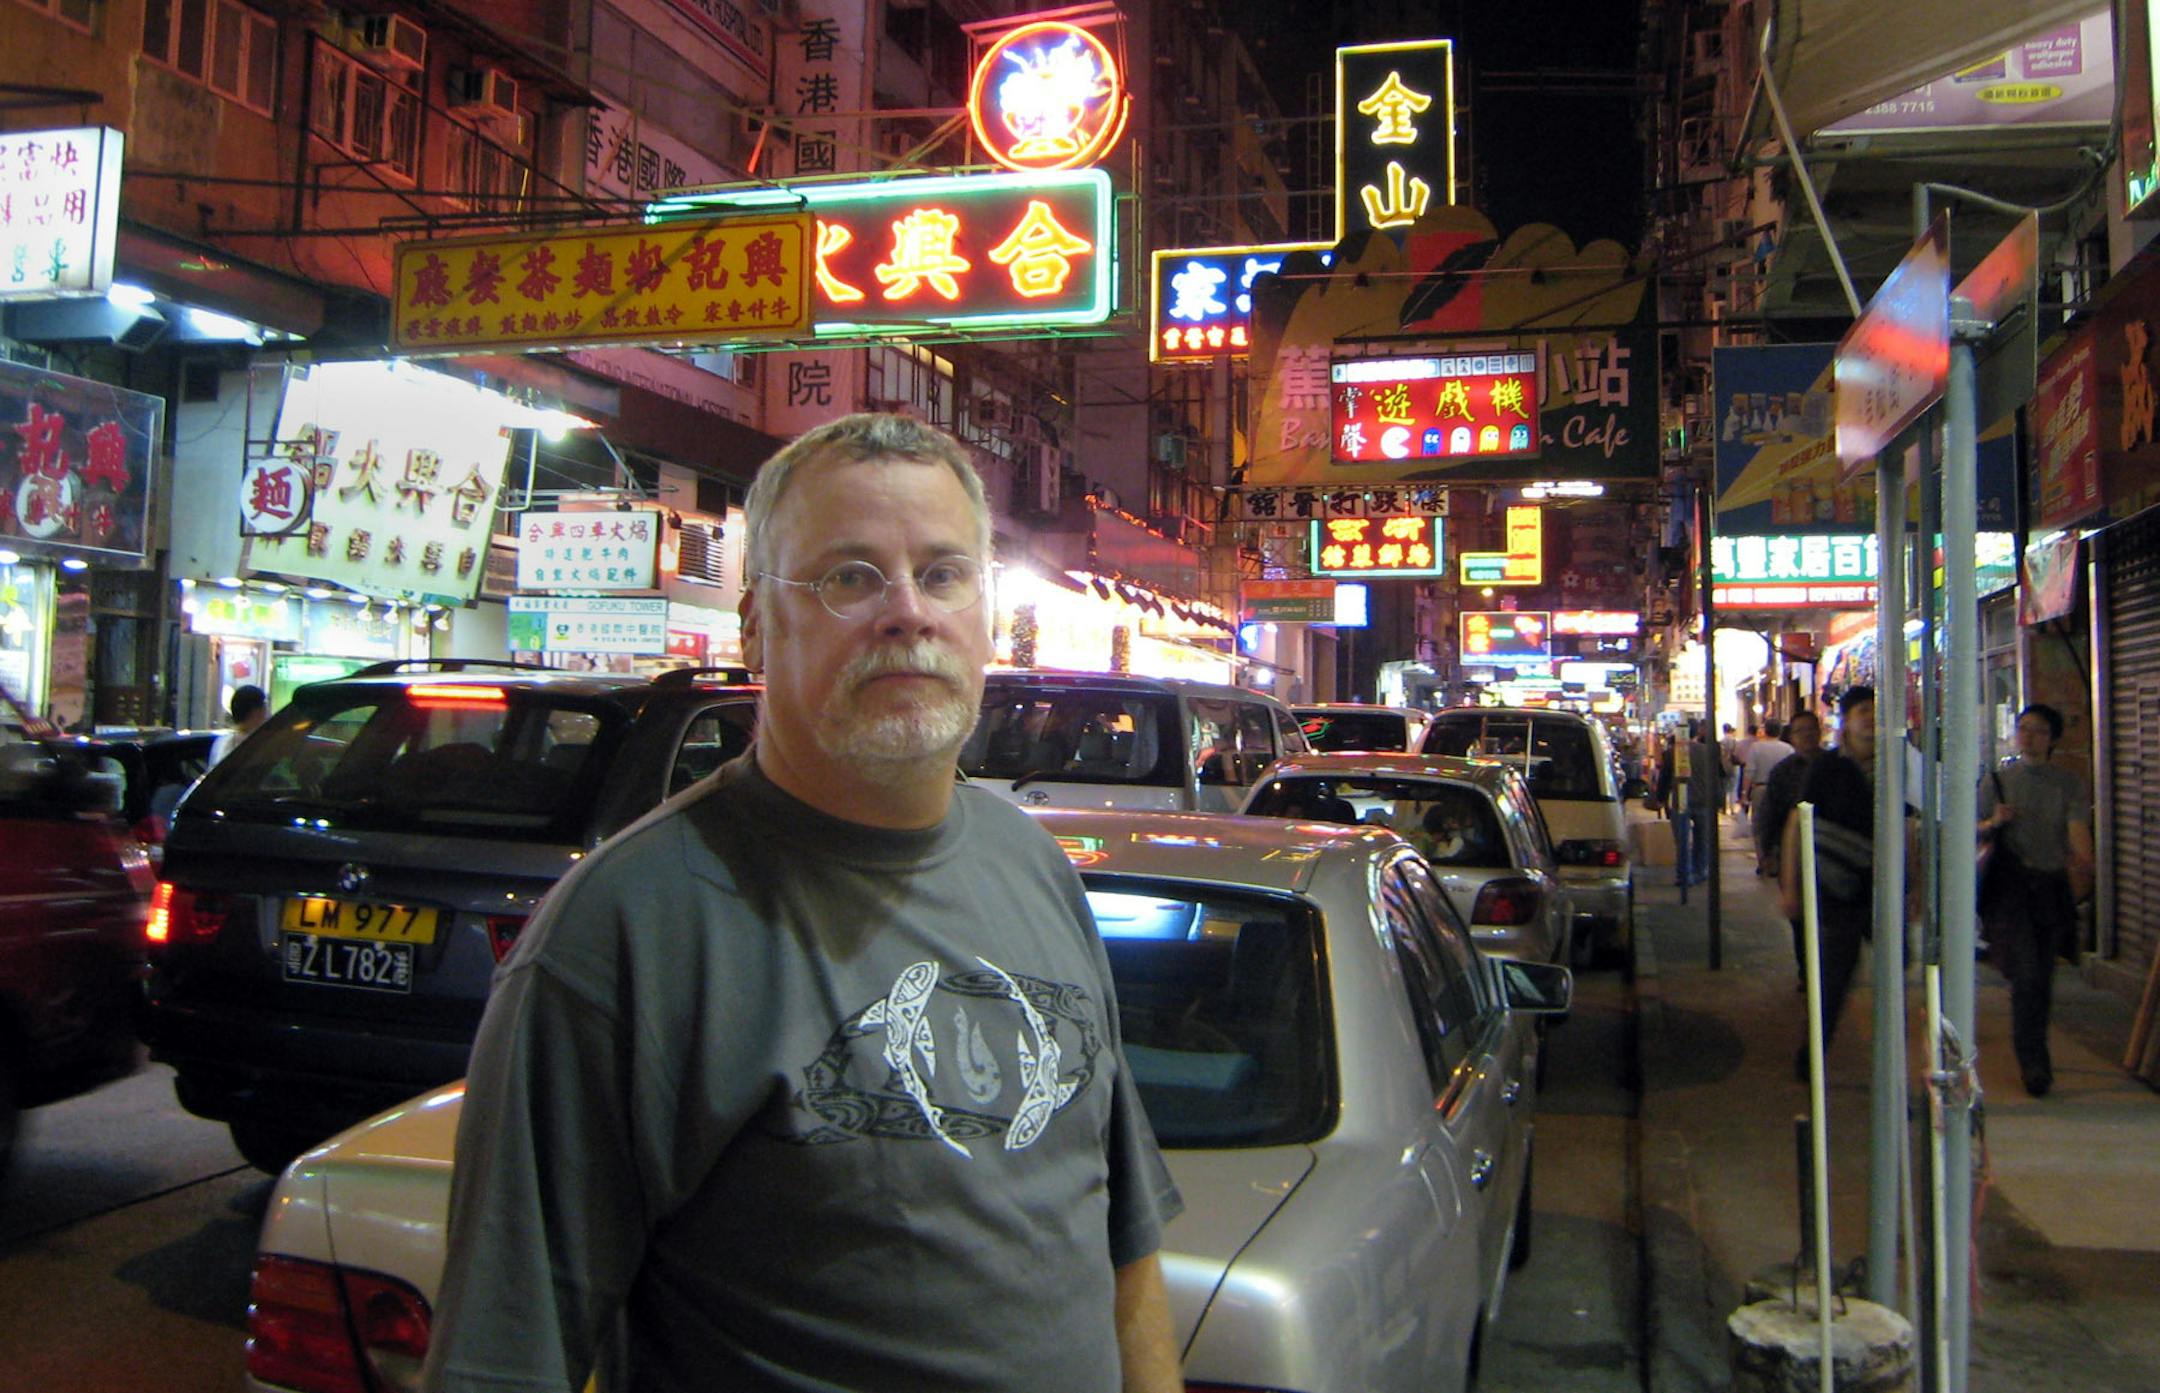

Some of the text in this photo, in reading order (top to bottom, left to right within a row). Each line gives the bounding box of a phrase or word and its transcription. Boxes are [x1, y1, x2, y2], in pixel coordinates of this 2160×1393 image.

[2056, 38, 2077, 49] duty
[795, 17, 842, 176] 香港國
[1357, 70, 1433, 229] 金山
[787, 360, 833, 407] 院
[1564, 413, 1630, 459] Cafe
[630, 601, 663, 612] TOWER
[300, 900, 418, 935] LM 977
